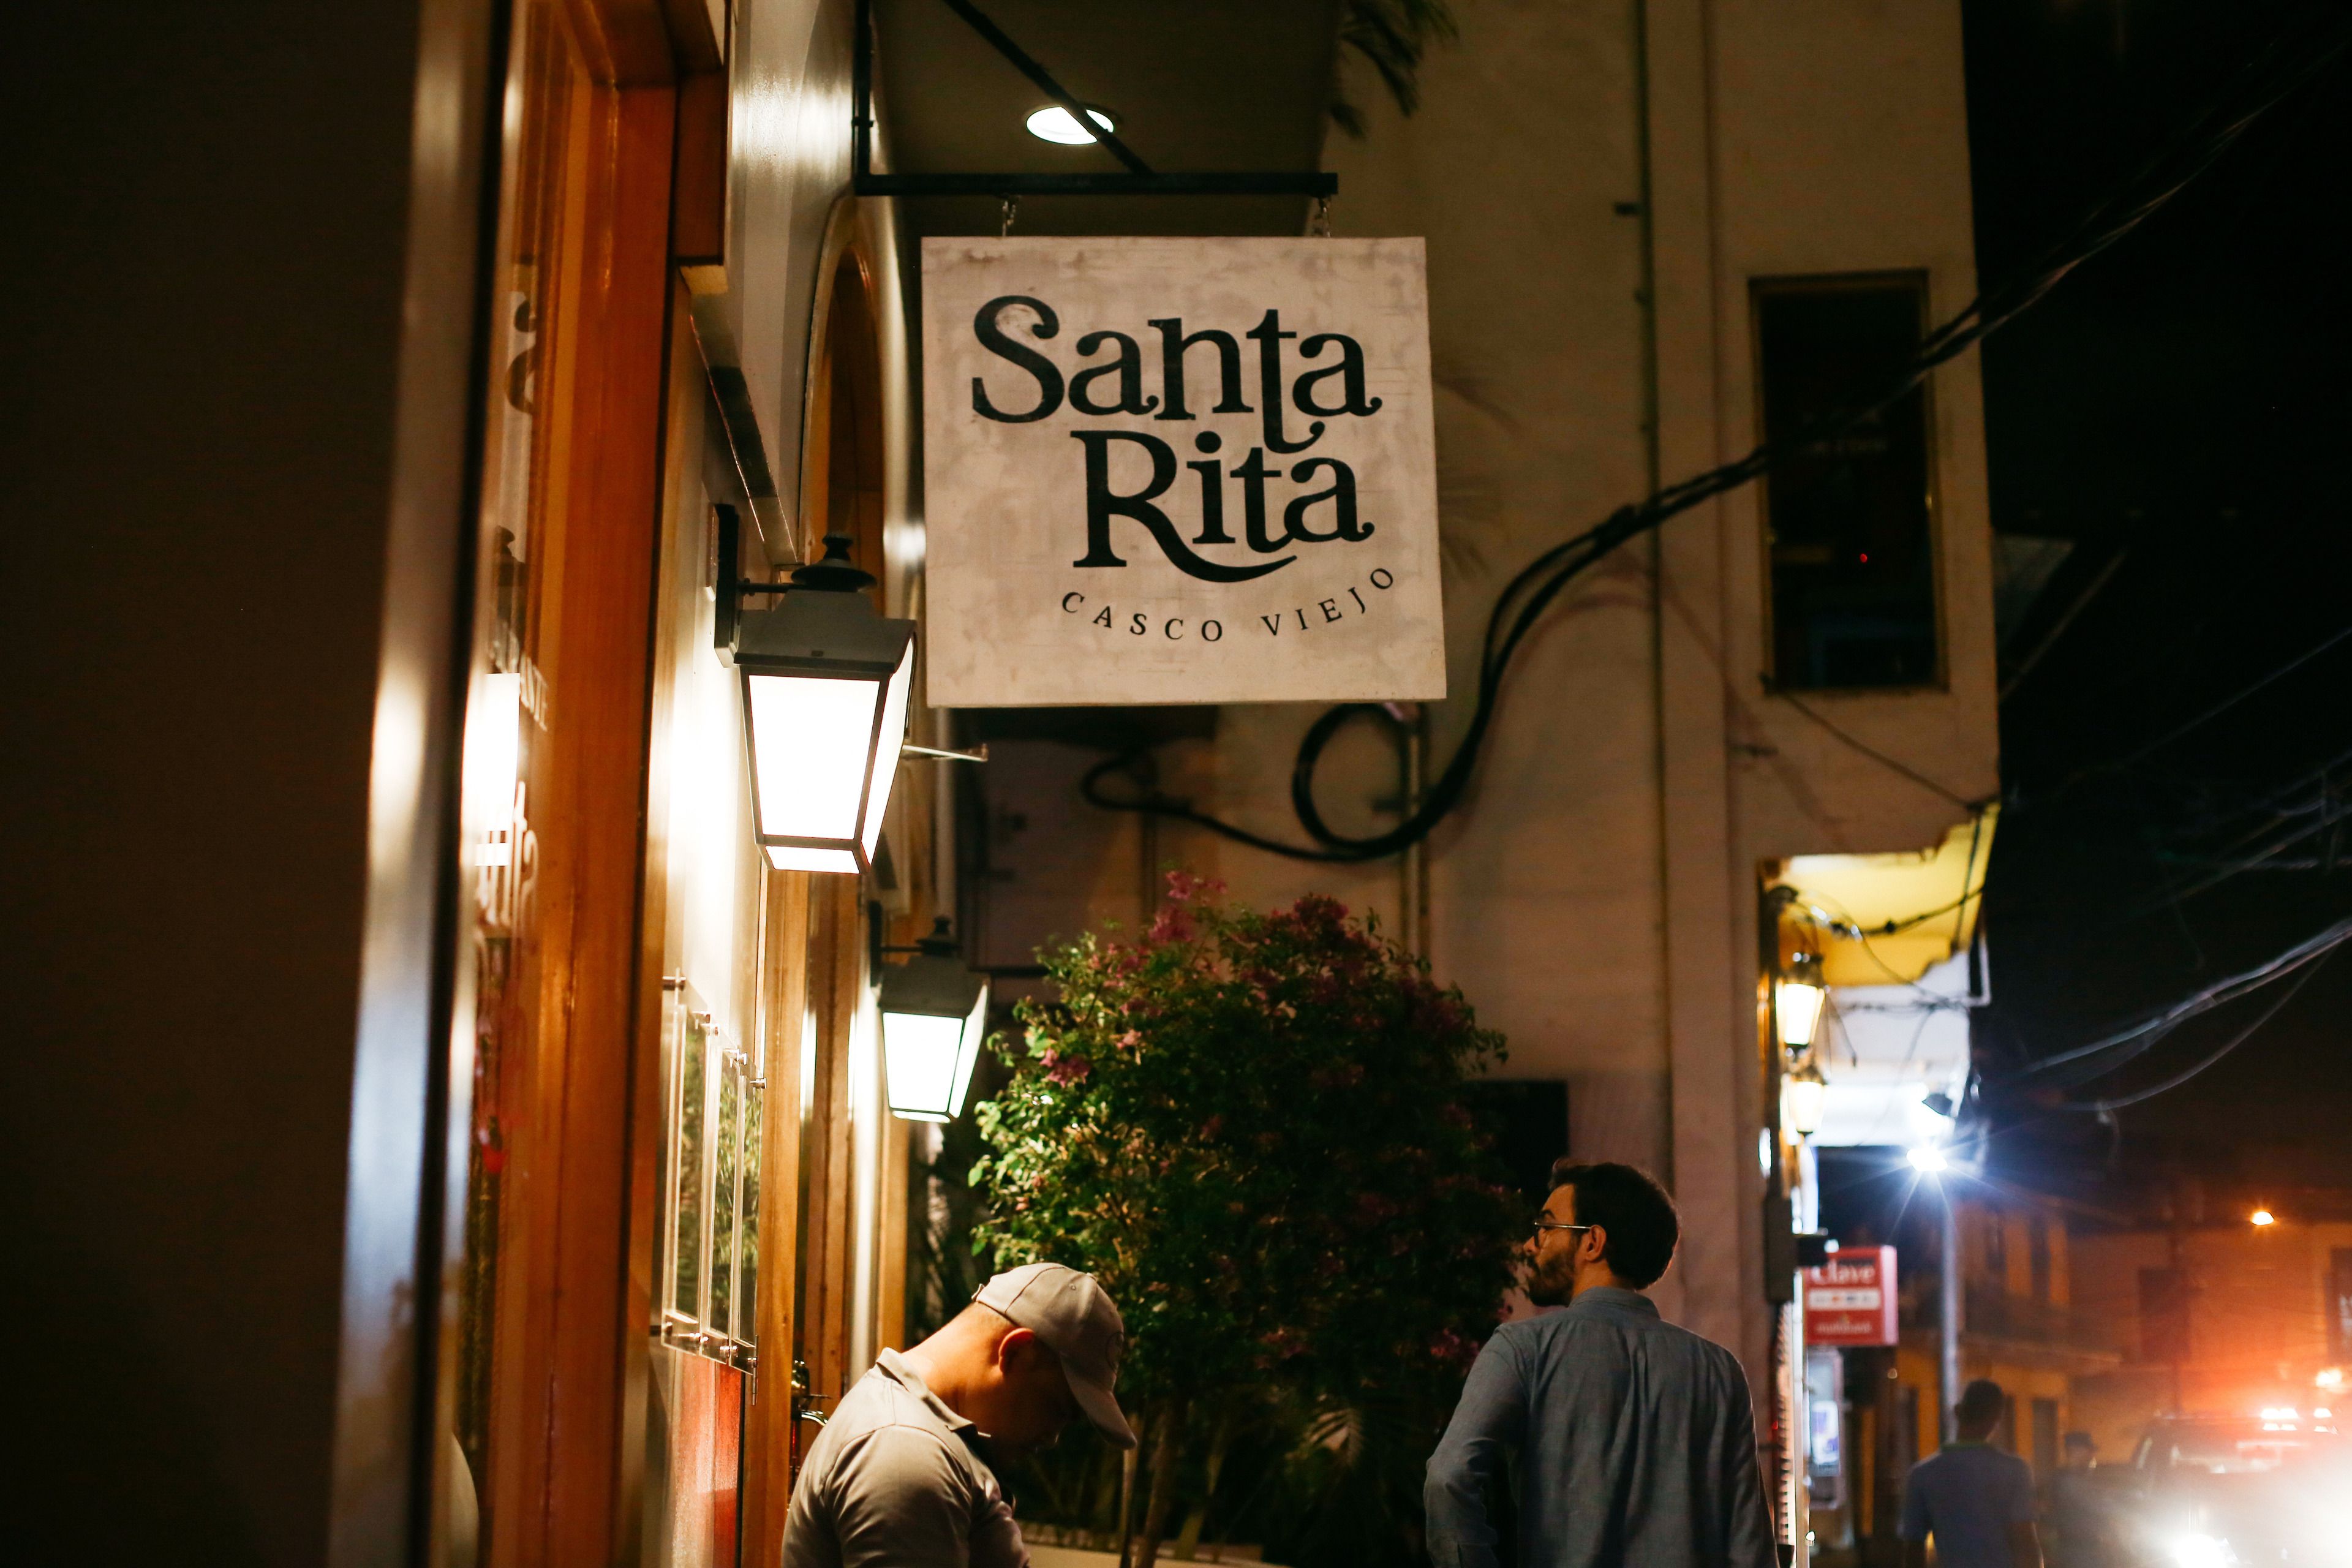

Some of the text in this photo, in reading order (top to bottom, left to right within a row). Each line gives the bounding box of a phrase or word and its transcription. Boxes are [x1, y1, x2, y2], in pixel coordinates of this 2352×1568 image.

[971, 295, 1383, 454] Santa
[1069, 429, 1376, 583] Rita
[1061, 567, 1395, 643] CASCO VIEJO
